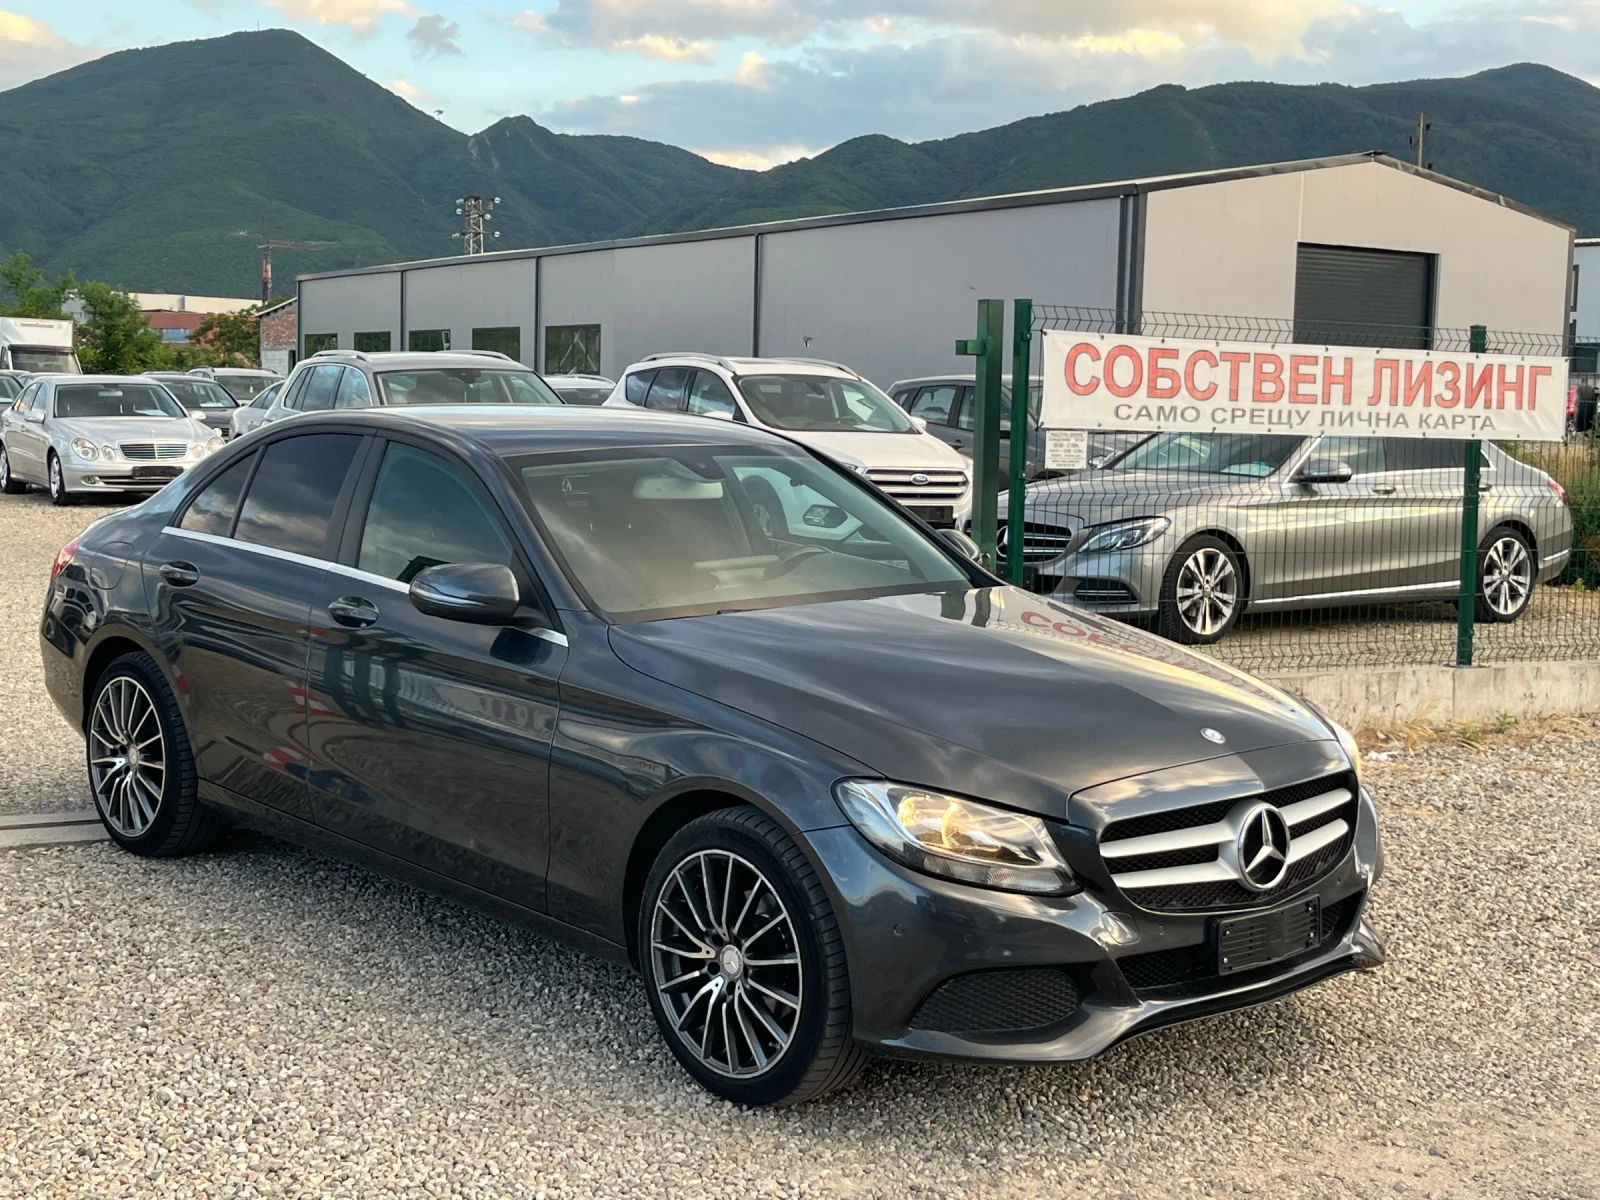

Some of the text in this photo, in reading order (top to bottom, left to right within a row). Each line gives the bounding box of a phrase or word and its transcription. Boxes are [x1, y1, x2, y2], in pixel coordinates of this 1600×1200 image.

[1064, 342, 1553, 411] СОБСТВЕН ЛИЗИНГ
[1113, 403, 1496, 431] САМО СРЕЩУ ЛИЧНА КАРТА
